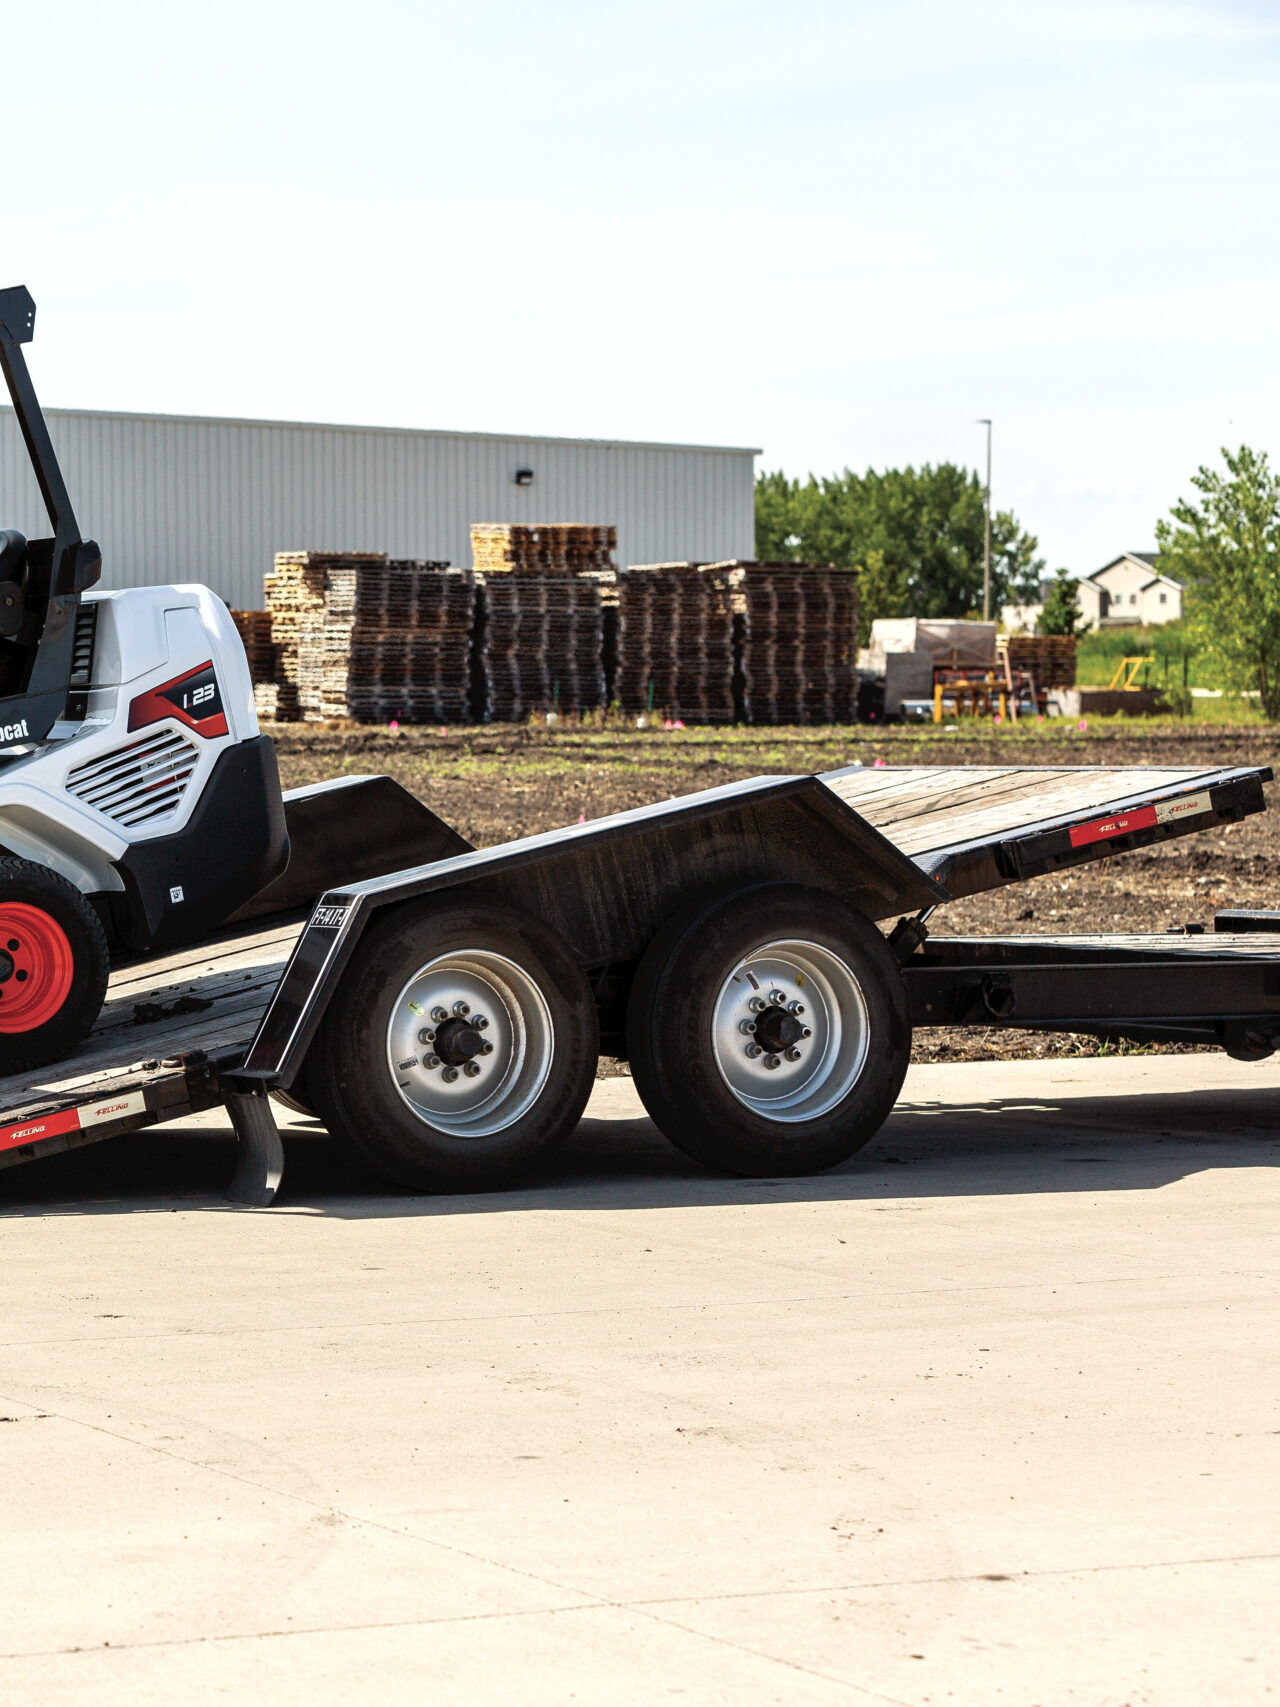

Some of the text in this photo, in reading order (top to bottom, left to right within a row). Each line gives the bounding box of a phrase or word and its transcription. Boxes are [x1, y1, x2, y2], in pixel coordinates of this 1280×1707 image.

[1168, 802, 1199, 814] FELLING
[94, 1102, 129, 1116] FELLING
[10, 1125, 46, 1140] FELLING
